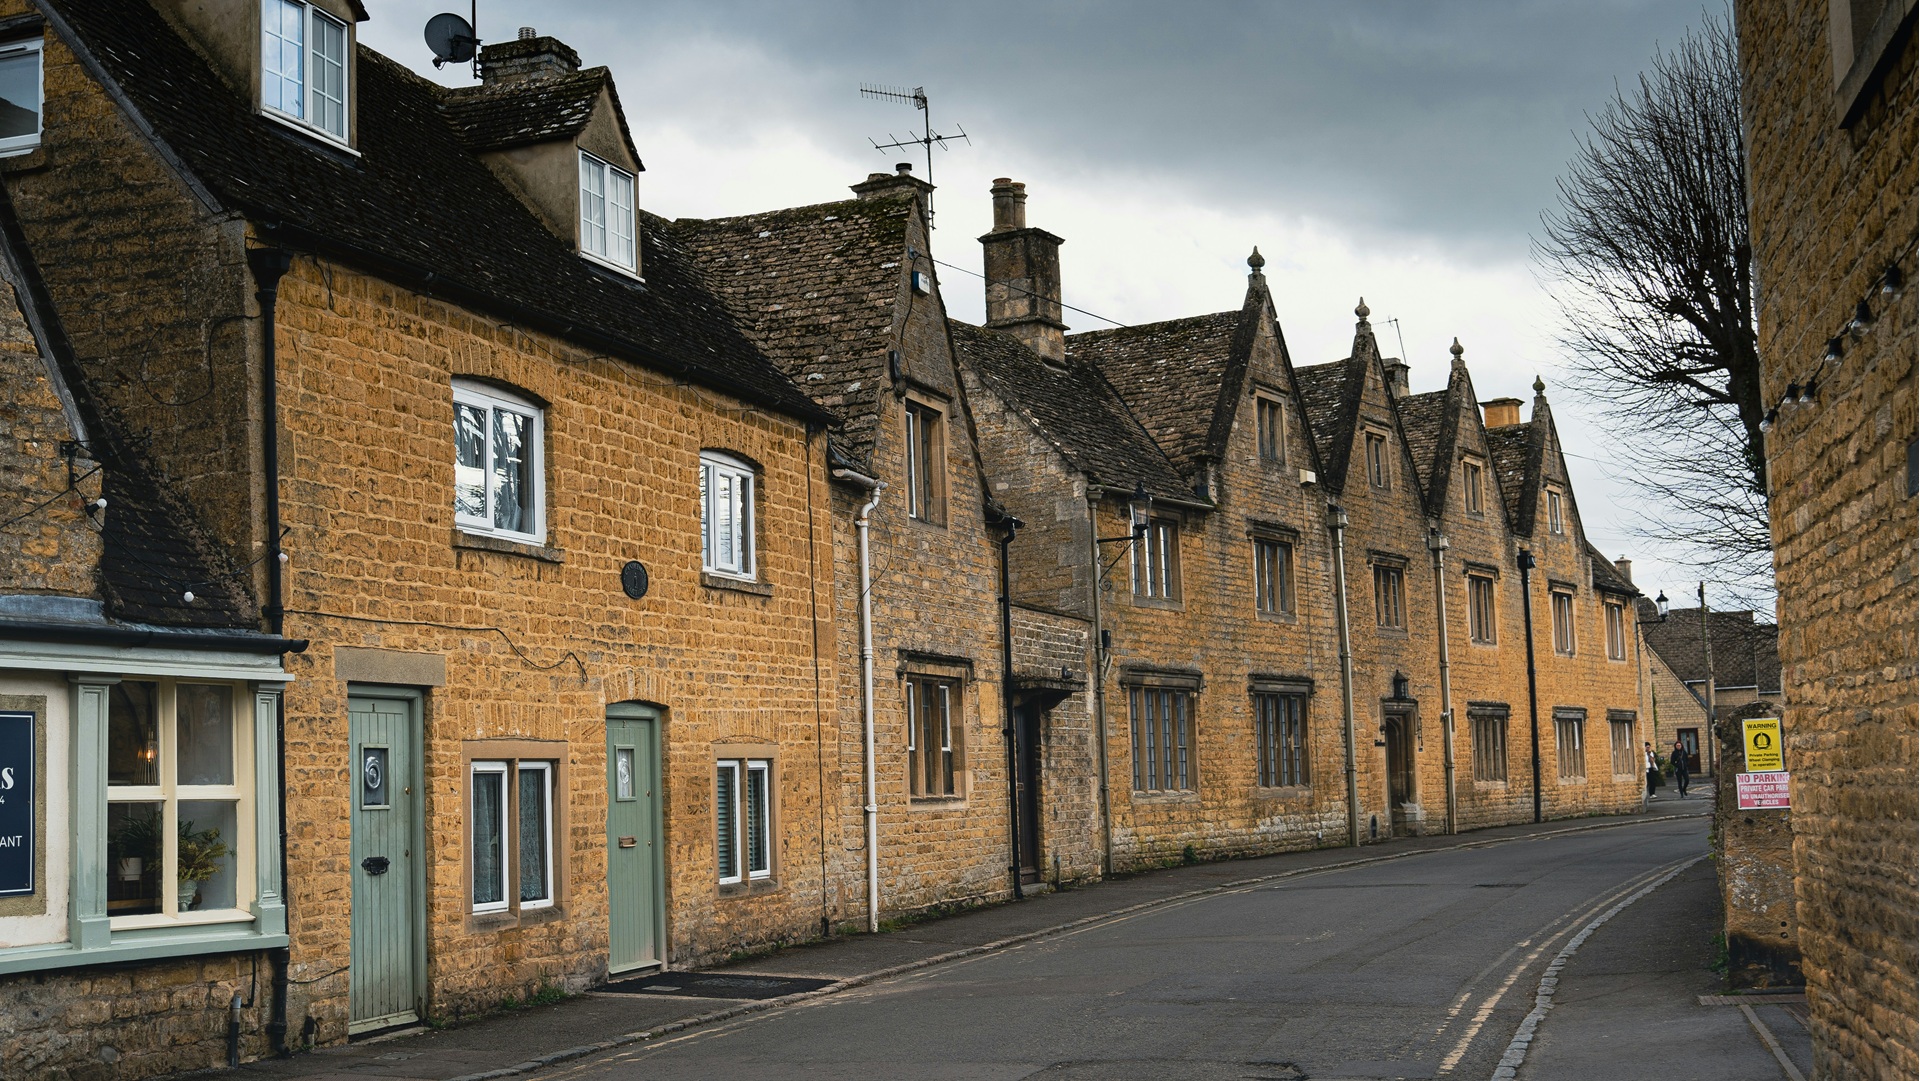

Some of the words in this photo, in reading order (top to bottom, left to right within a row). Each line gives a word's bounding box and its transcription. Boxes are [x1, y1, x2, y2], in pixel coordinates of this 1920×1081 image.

[371, 703, 375, 713] 1
[1738, 774, 1750, 783] NO
[0, 835, 23, 848] ANT
